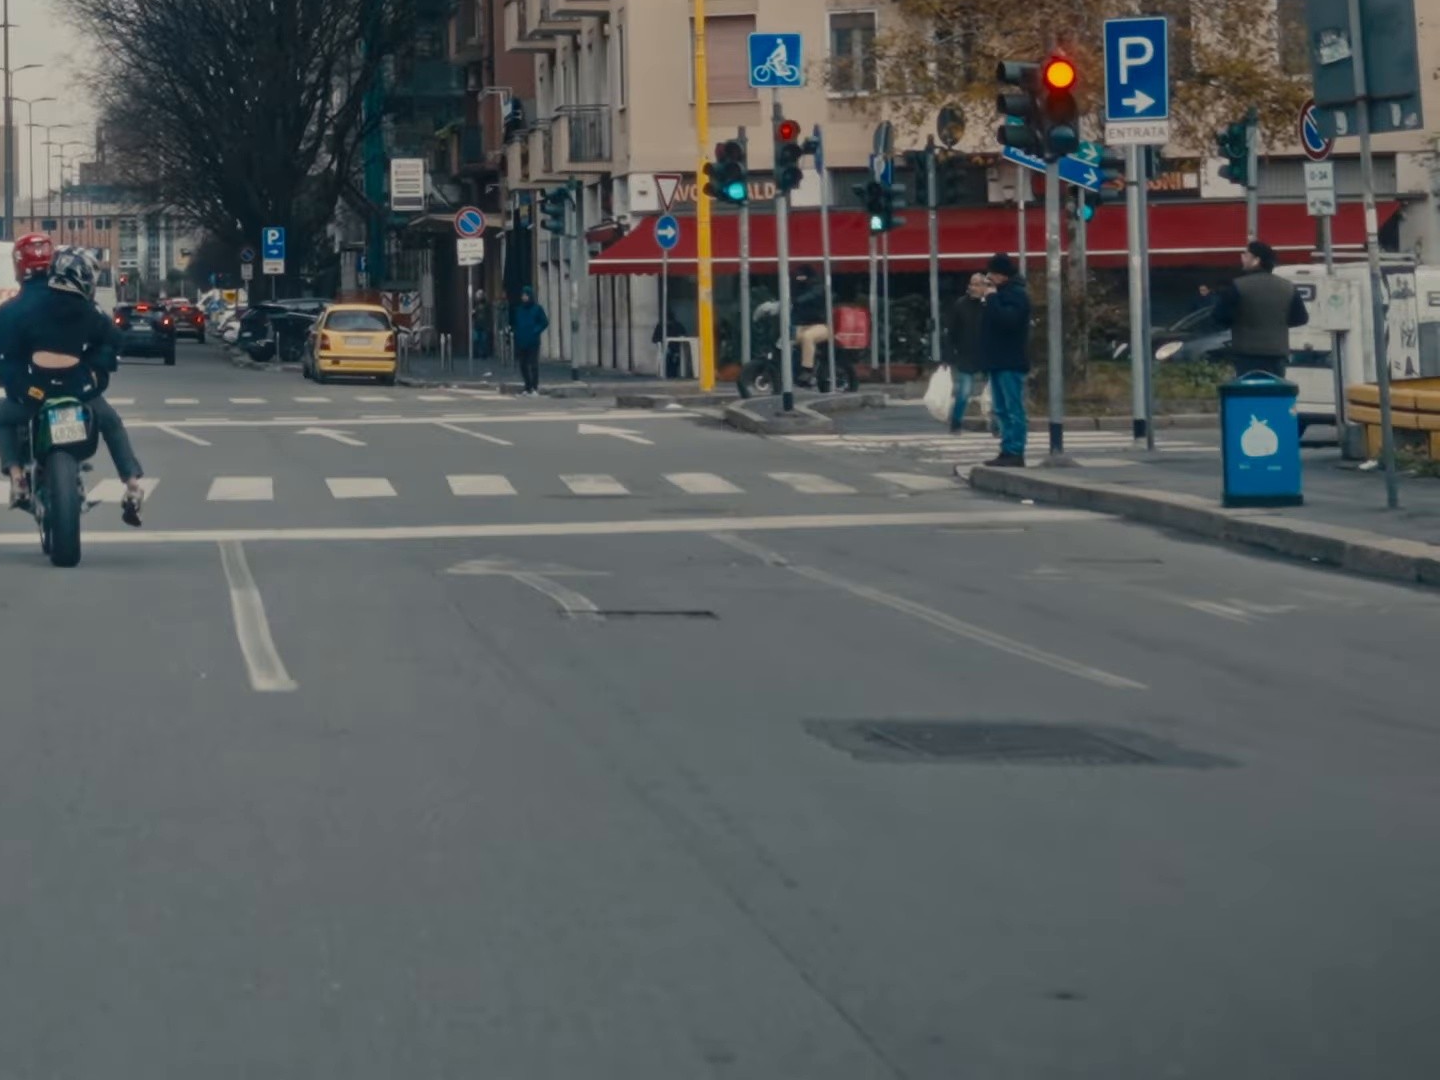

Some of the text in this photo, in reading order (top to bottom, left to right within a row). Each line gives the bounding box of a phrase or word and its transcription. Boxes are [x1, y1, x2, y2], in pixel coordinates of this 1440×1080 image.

[1118, 36, 1154, 85] P
[1108, 124, 1167, 138] ENTRATA
[267, 229, 280, 246] P
